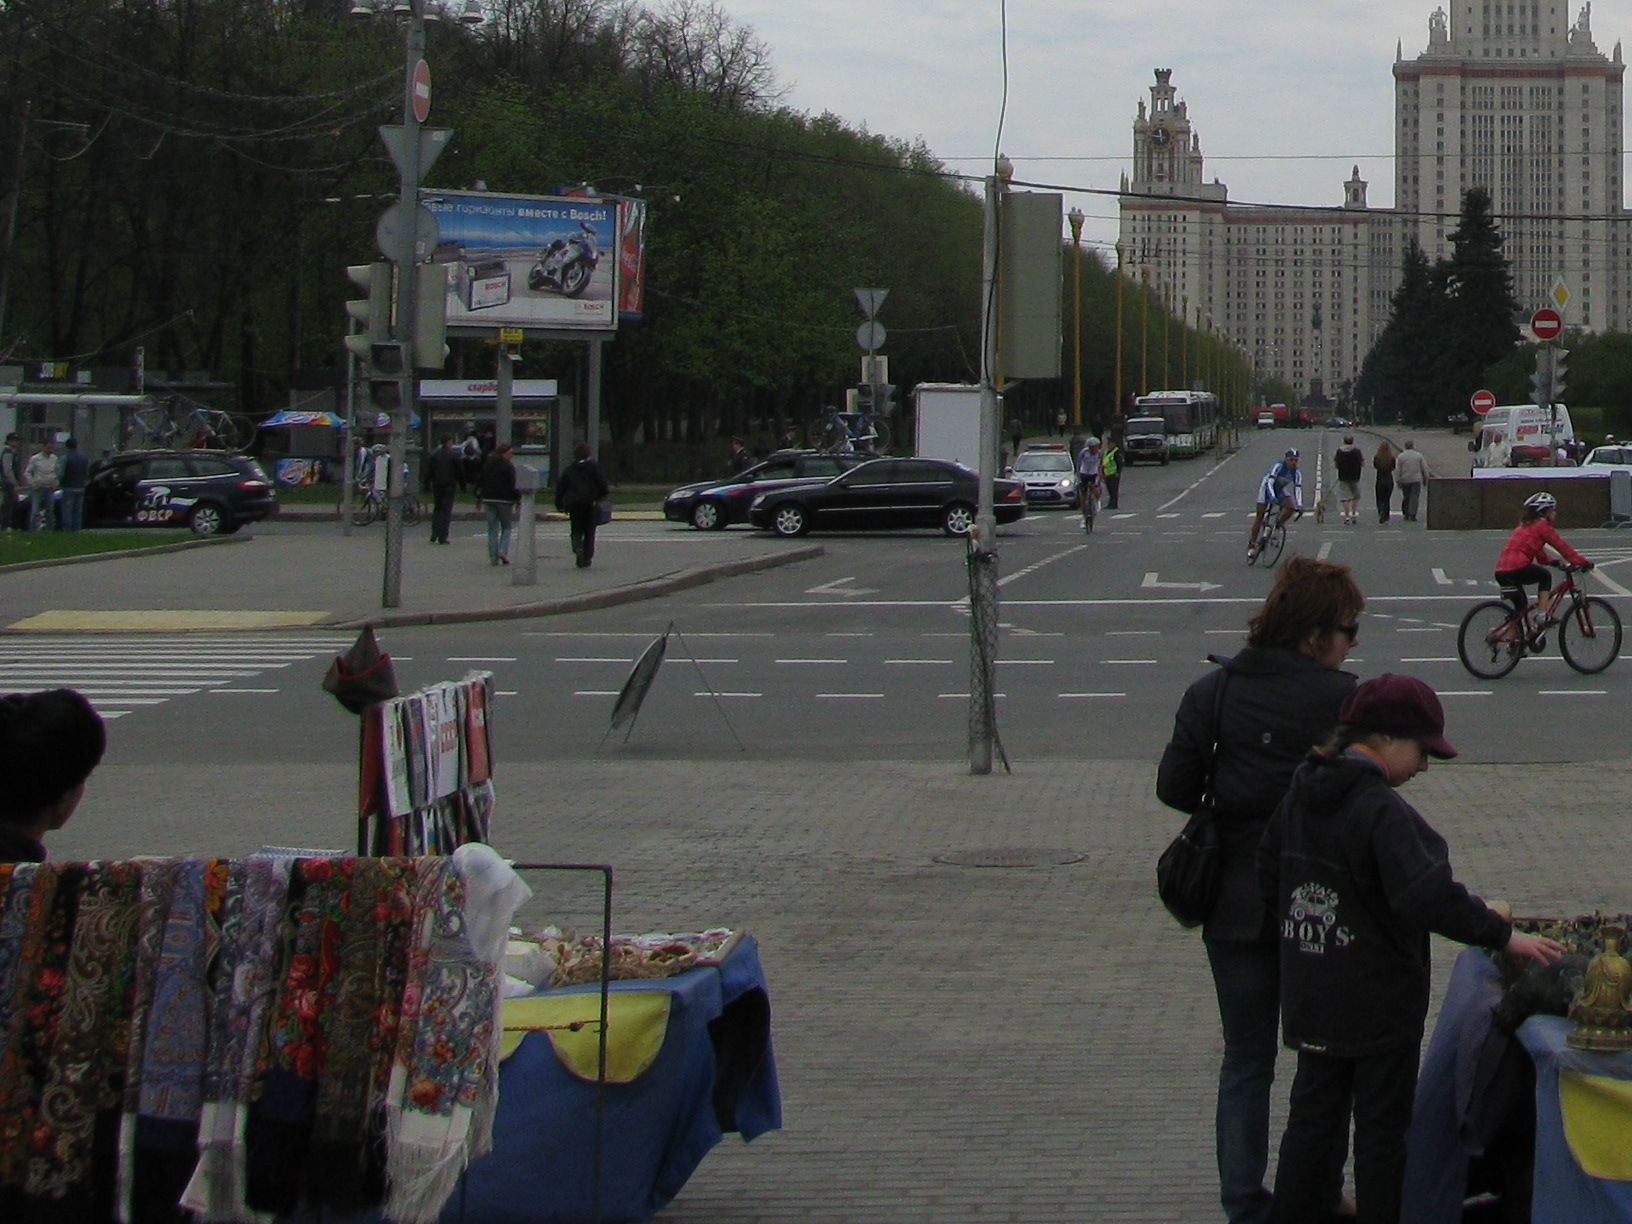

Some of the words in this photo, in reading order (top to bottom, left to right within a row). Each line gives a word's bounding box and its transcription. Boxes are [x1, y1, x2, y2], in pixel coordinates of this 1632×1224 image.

[457, 204, 515, 217] горизонты
[517, 208, 559, 219] вместе
[569, 208, 607, 222] Bosch!
[484, 282, 507, 290] BOSCH
[583, 302, 604, 310] BOSCH
[1283, 919, 1350, 947] BOYS
